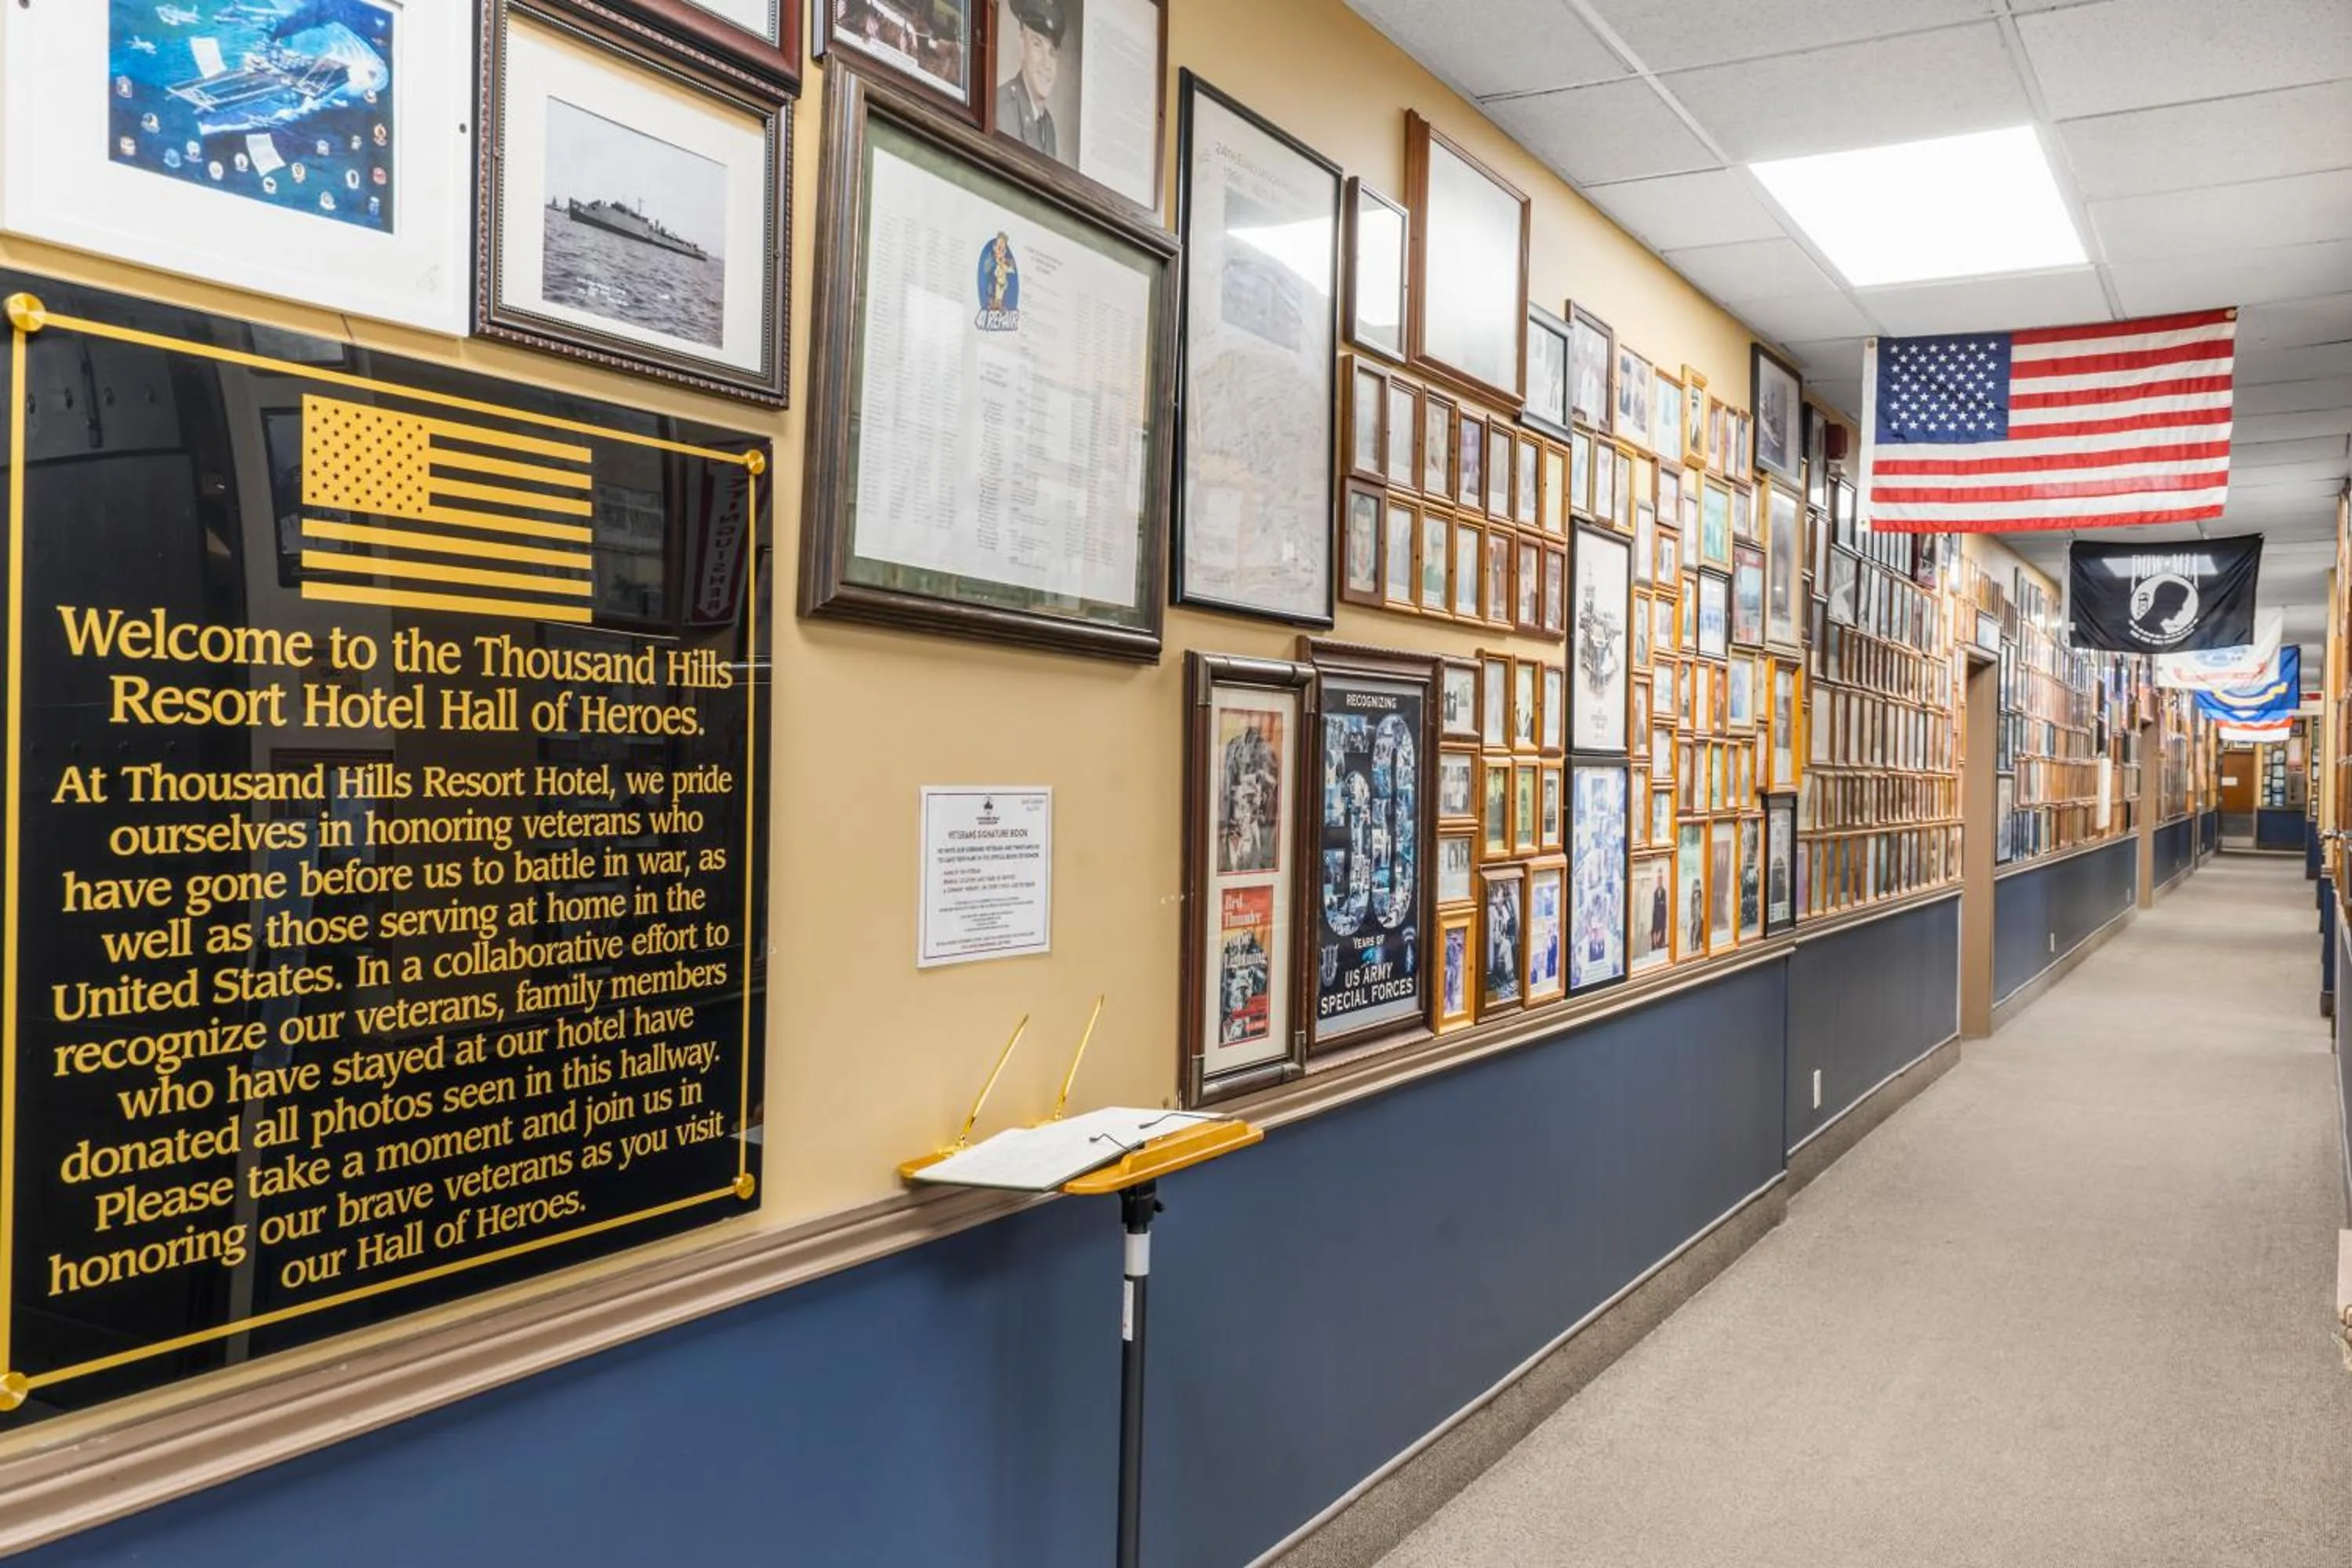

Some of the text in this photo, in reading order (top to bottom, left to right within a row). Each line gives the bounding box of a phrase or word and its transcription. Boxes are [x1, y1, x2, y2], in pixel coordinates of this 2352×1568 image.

[58, 605, 732, 688] Welcome to the Thousand Hills
[111, 676, 706, 735] Resort Hotel Hall of Heroes.
[1346, 694, 1397, 709] RECOGNIZING
[52, 763, 731, 803] At Thousand Hills Resort Hotel, we pride
[110, 804, 702, 855] ourselves in honoring veterans who
[1009, 828, 1029, 838] BOOK
[64, 848, 725, 916] have gone before us to battle in war, as
[103, 883, 706, 962] well as those serving at home in the
[1352, 935, 1386, 949] YEARS OF
[53, 924, 729, 1021] United States. In a collaborative effort to
[1320, 977, 1414, 1016] SPECIAL FORCES
[1345, 962, 1394, 989] US ARMY
[55, 961, 726, 1076] recognize our veterans, family members
[119, 1008, 694, 1120] who have stayed at our hotel have
[61, 1044, 720, 1183] donated all photos seen in this hallway.
[96, 1083, 701, 1230] Please take a moment and join us in
[50, 1113, 722, 1295] honoring our brave veterans as you visit
[282, 1192, 586, 1287] our Hall of Heroes.
